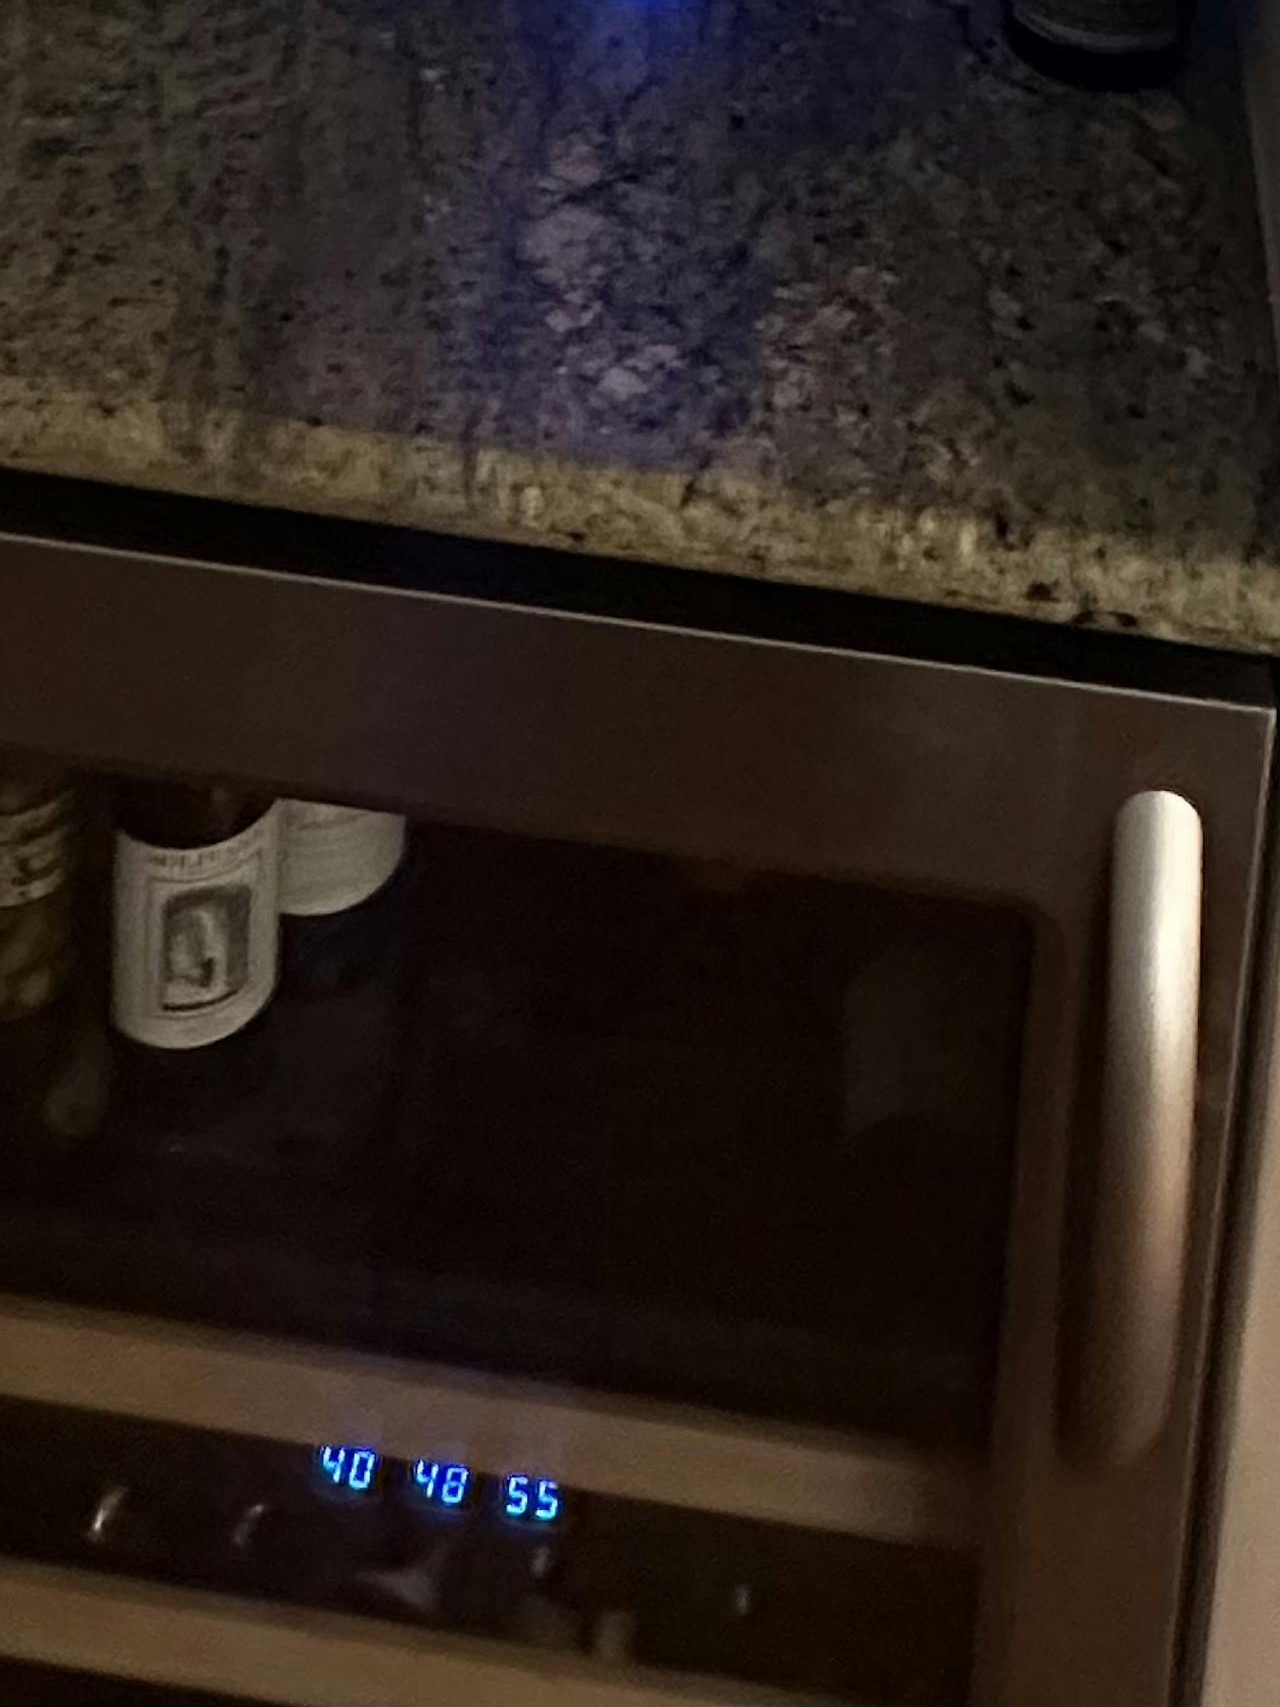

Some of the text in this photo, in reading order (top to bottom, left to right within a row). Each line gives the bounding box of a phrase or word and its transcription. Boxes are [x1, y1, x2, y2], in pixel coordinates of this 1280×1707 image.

[321, 1445, 559, 1520] 40 48 55
